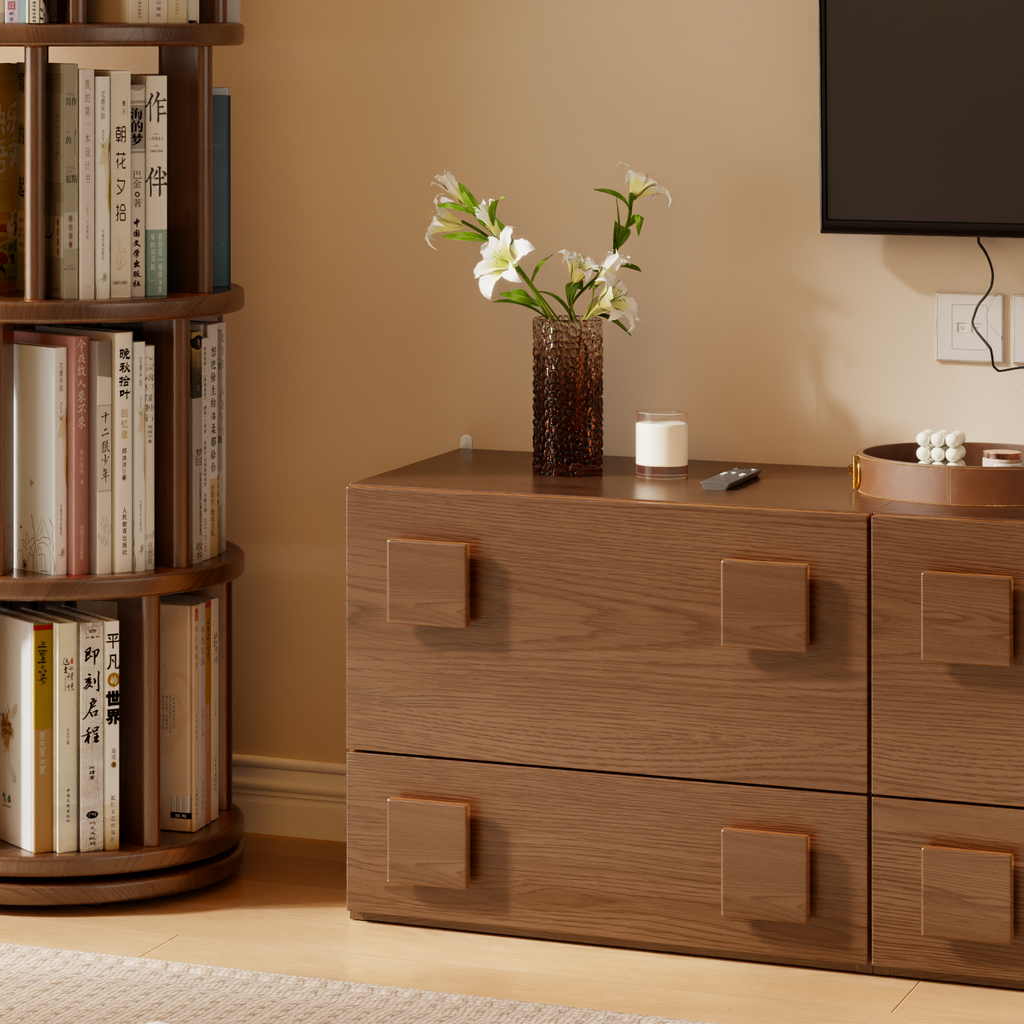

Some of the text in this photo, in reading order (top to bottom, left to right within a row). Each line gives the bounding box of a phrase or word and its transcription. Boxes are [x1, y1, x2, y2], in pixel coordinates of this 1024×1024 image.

[131, 107, 144, 146] 海的梦
[115, 125, 127, 222] 朝花夕拾
[132, 218, 142, 288] 中国文学出版社
[119, 347, 131, 400] 晚秋拾叶
[101, 411, 111, 484] 十二狼少年
[120, 408, 129, 440] 回忆录
[80, 646, 101, 745] 即刻启程
[105, 632, 121, 726] 平凡的世界
